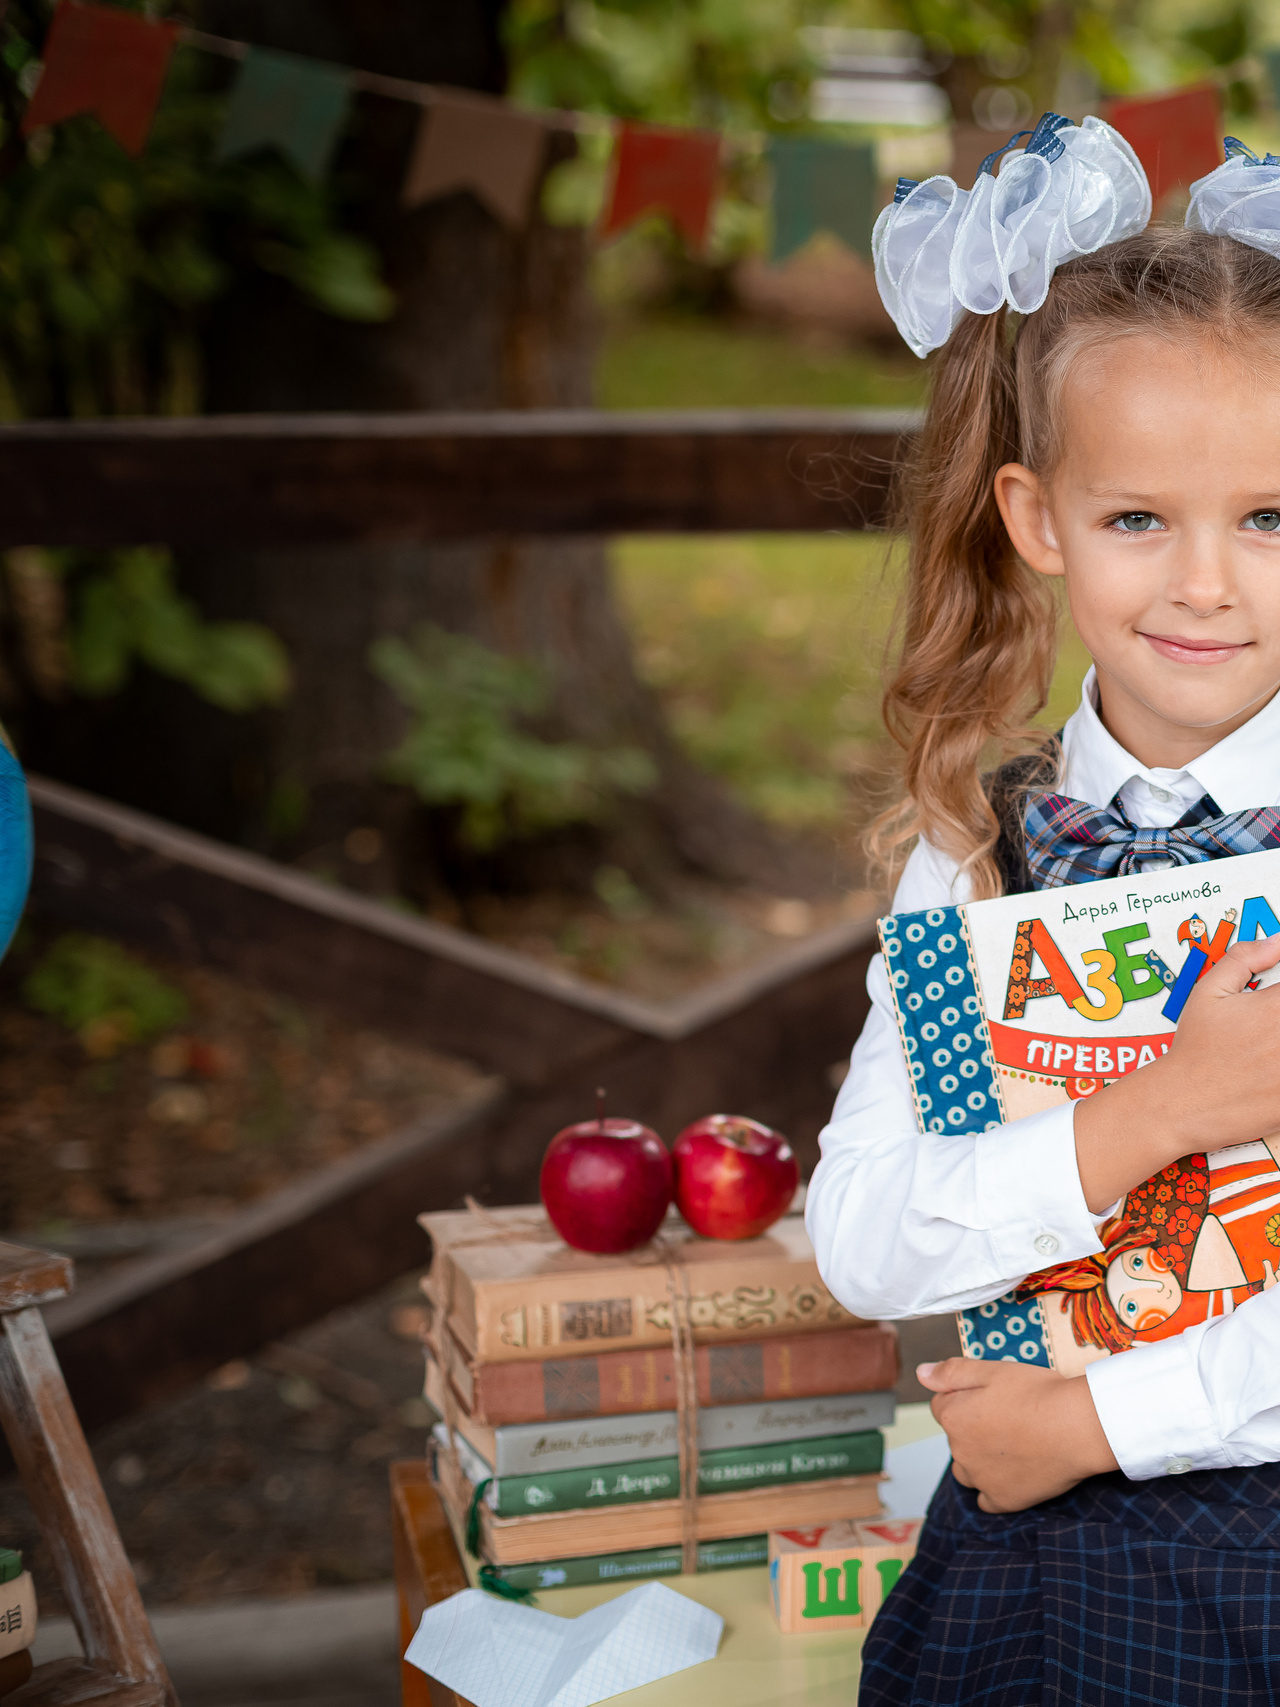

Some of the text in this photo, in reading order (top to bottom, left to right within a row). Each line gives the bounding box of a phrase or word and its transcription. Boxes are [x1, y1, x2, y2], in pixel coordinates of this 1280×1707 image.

[1063, 882, 1221, 923] Дарья Герасимова
[1027, 1039, 1169, 1073] ПРЕВРА
